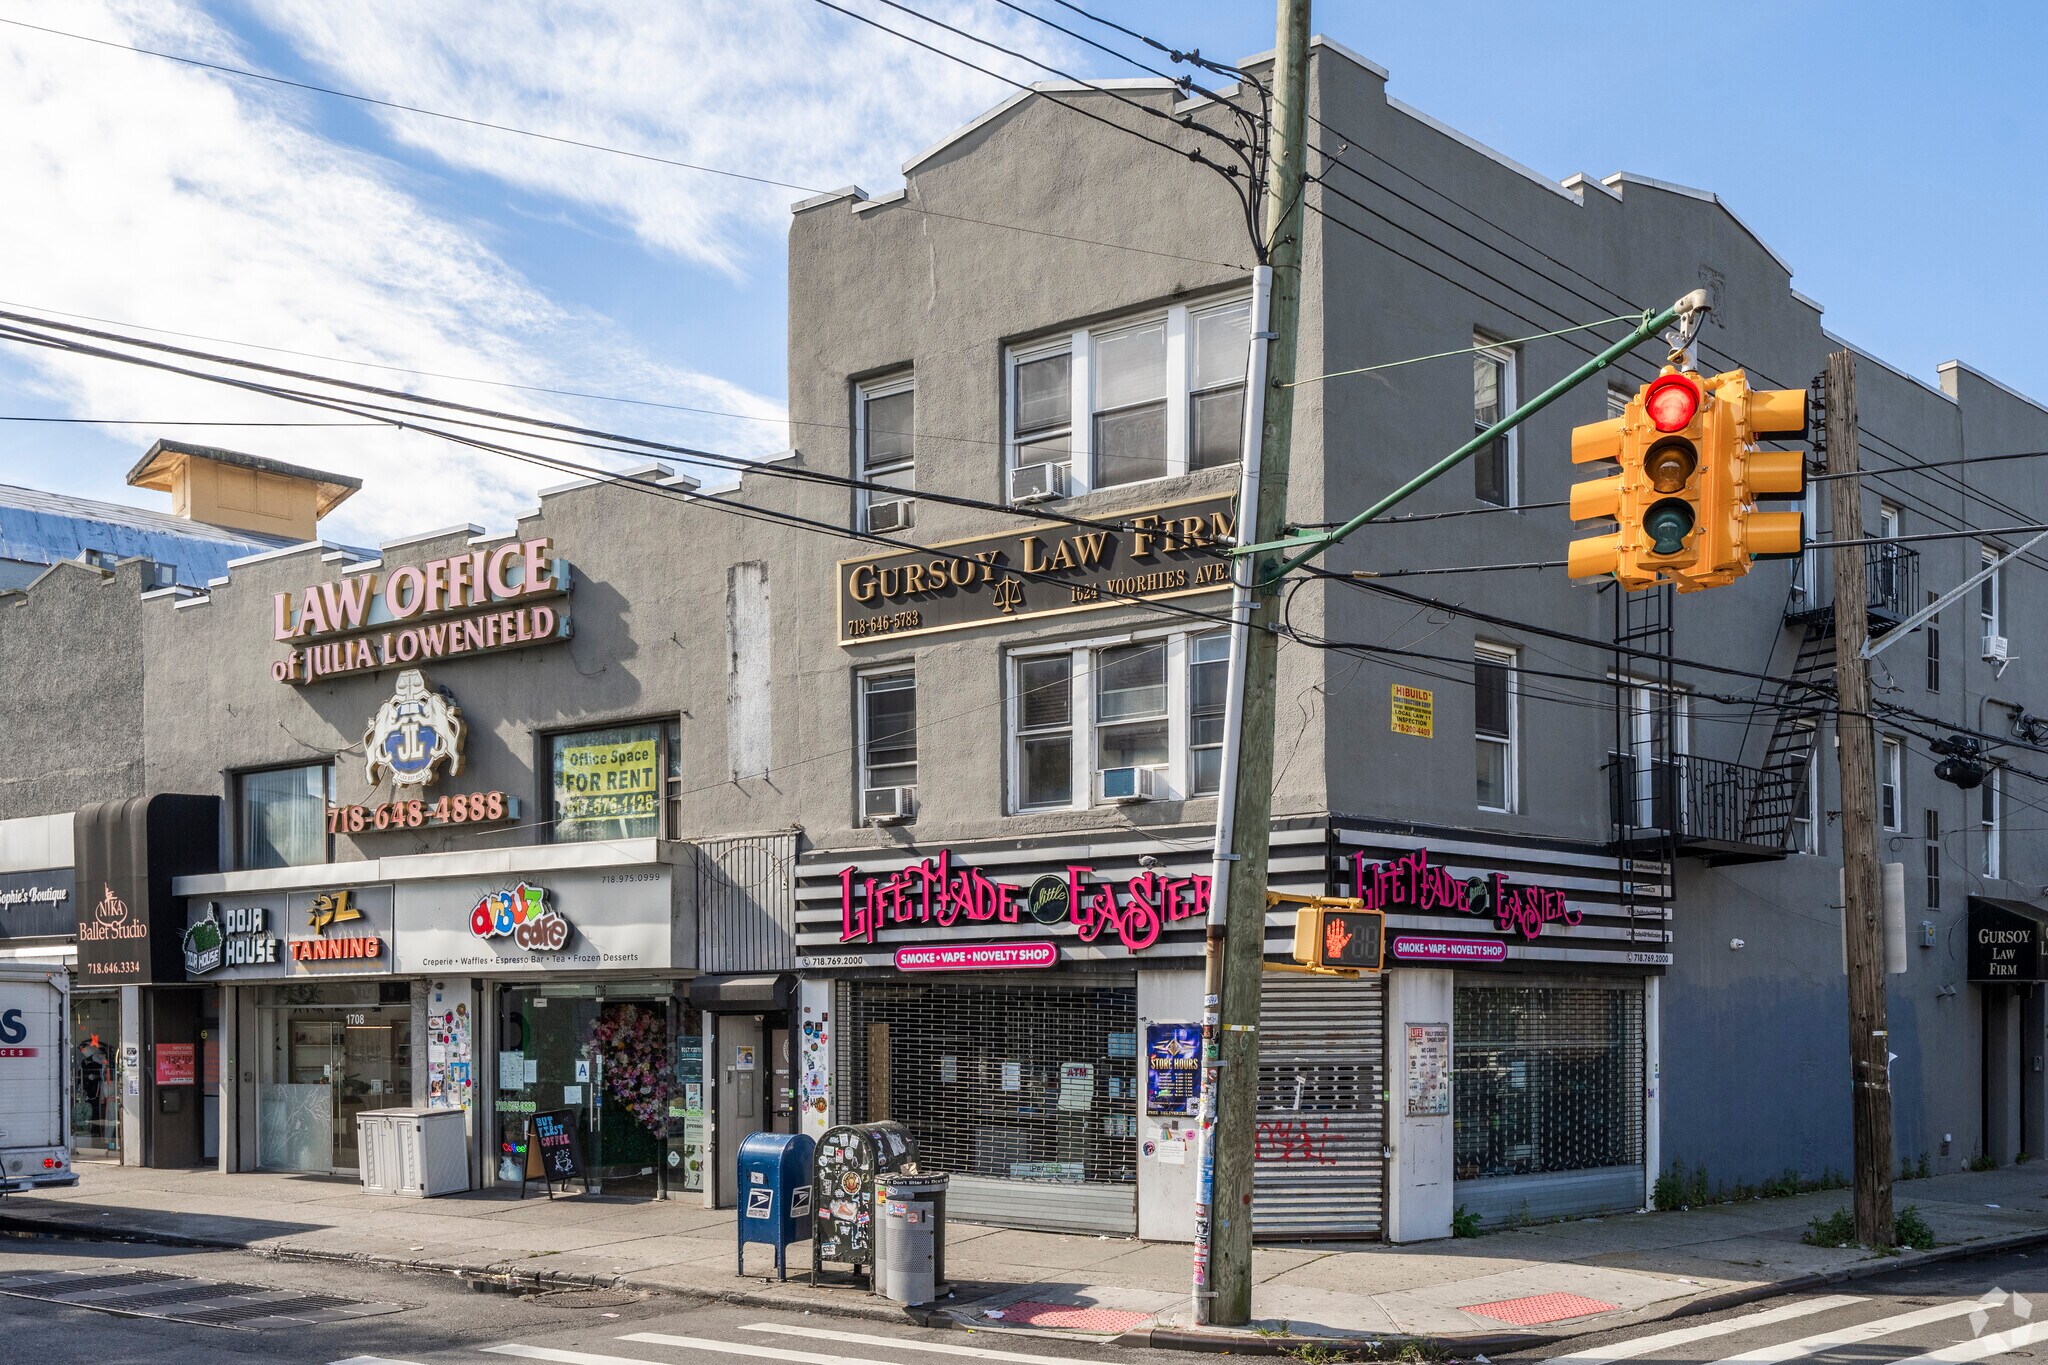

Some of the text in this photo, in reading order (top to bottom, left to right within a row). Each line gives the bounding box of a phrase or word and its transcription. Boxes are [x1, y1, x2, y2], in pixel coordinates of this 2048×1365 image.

[850, 550, 1000, 601] GURSOY
[1020, 531, 1110, 573] LAW
[273, 537, 555, 641] LAW OFFICE
[1071, 563, 1229, 603] 1624 VOORHIES AVE.
[848, 610, 919, 635] 718-646-5783
[271, 606, 554, 684] of JULIA LOWENFELD
[1396, 686, 1428, 701] HIBUILD
[1397, 716, 1427, 726] INSPECTION
[397, 723, 424, 762] JL
[570, 750, 649, 767] Office Space
[566, 768, 653, 792] FOR RENT
[327, 791, 503, 833] 718-648-4888
[601, 873, 661, 884] 718.975.0999
[29, 886, 67, 907] Boutique
[838, 848, 1019, 944] LIFE MADE
[79, 919, 147, 941] Ballet Studio
[1978, 928, 2031, 944] GURSOY
[226, 938, 276, 967] HOUSE
[289, 936, 379, 961] TANNING
[1397, 943, 1503, 956] SMOKE VAPE NOVELTY SHOP
[1992, 948, 2016, 960] LAW
[422, 953, 638, 967] Creperie Waffles Espresso Bar Tea Frozen Desserts
[812, 957, 863, 966] 718.769.2000
[901, 949, 1050, 964] SMOKE VAPE NOVELTY SHOP
[1634, 954, 1669, 963] 718.769.2000
[87, 961, 140, 974] 718.646.3334
[1989, 963, 2018, 975] FIRM
[346, 1014, 365, 1025] 1708
[1411, 1028, 1423, 1037] LIFE
[579, 1063, 588, 1077] A
[1151, 1058, 1198, 1070] STORE HOURS
[1067, 1067, 1087, 1077] ATM
[536, 1116, 553, 1127] BUT
[539, 1124, 564, 1138] FIRST
[541, 1134, 570, 1147] COFFEE
